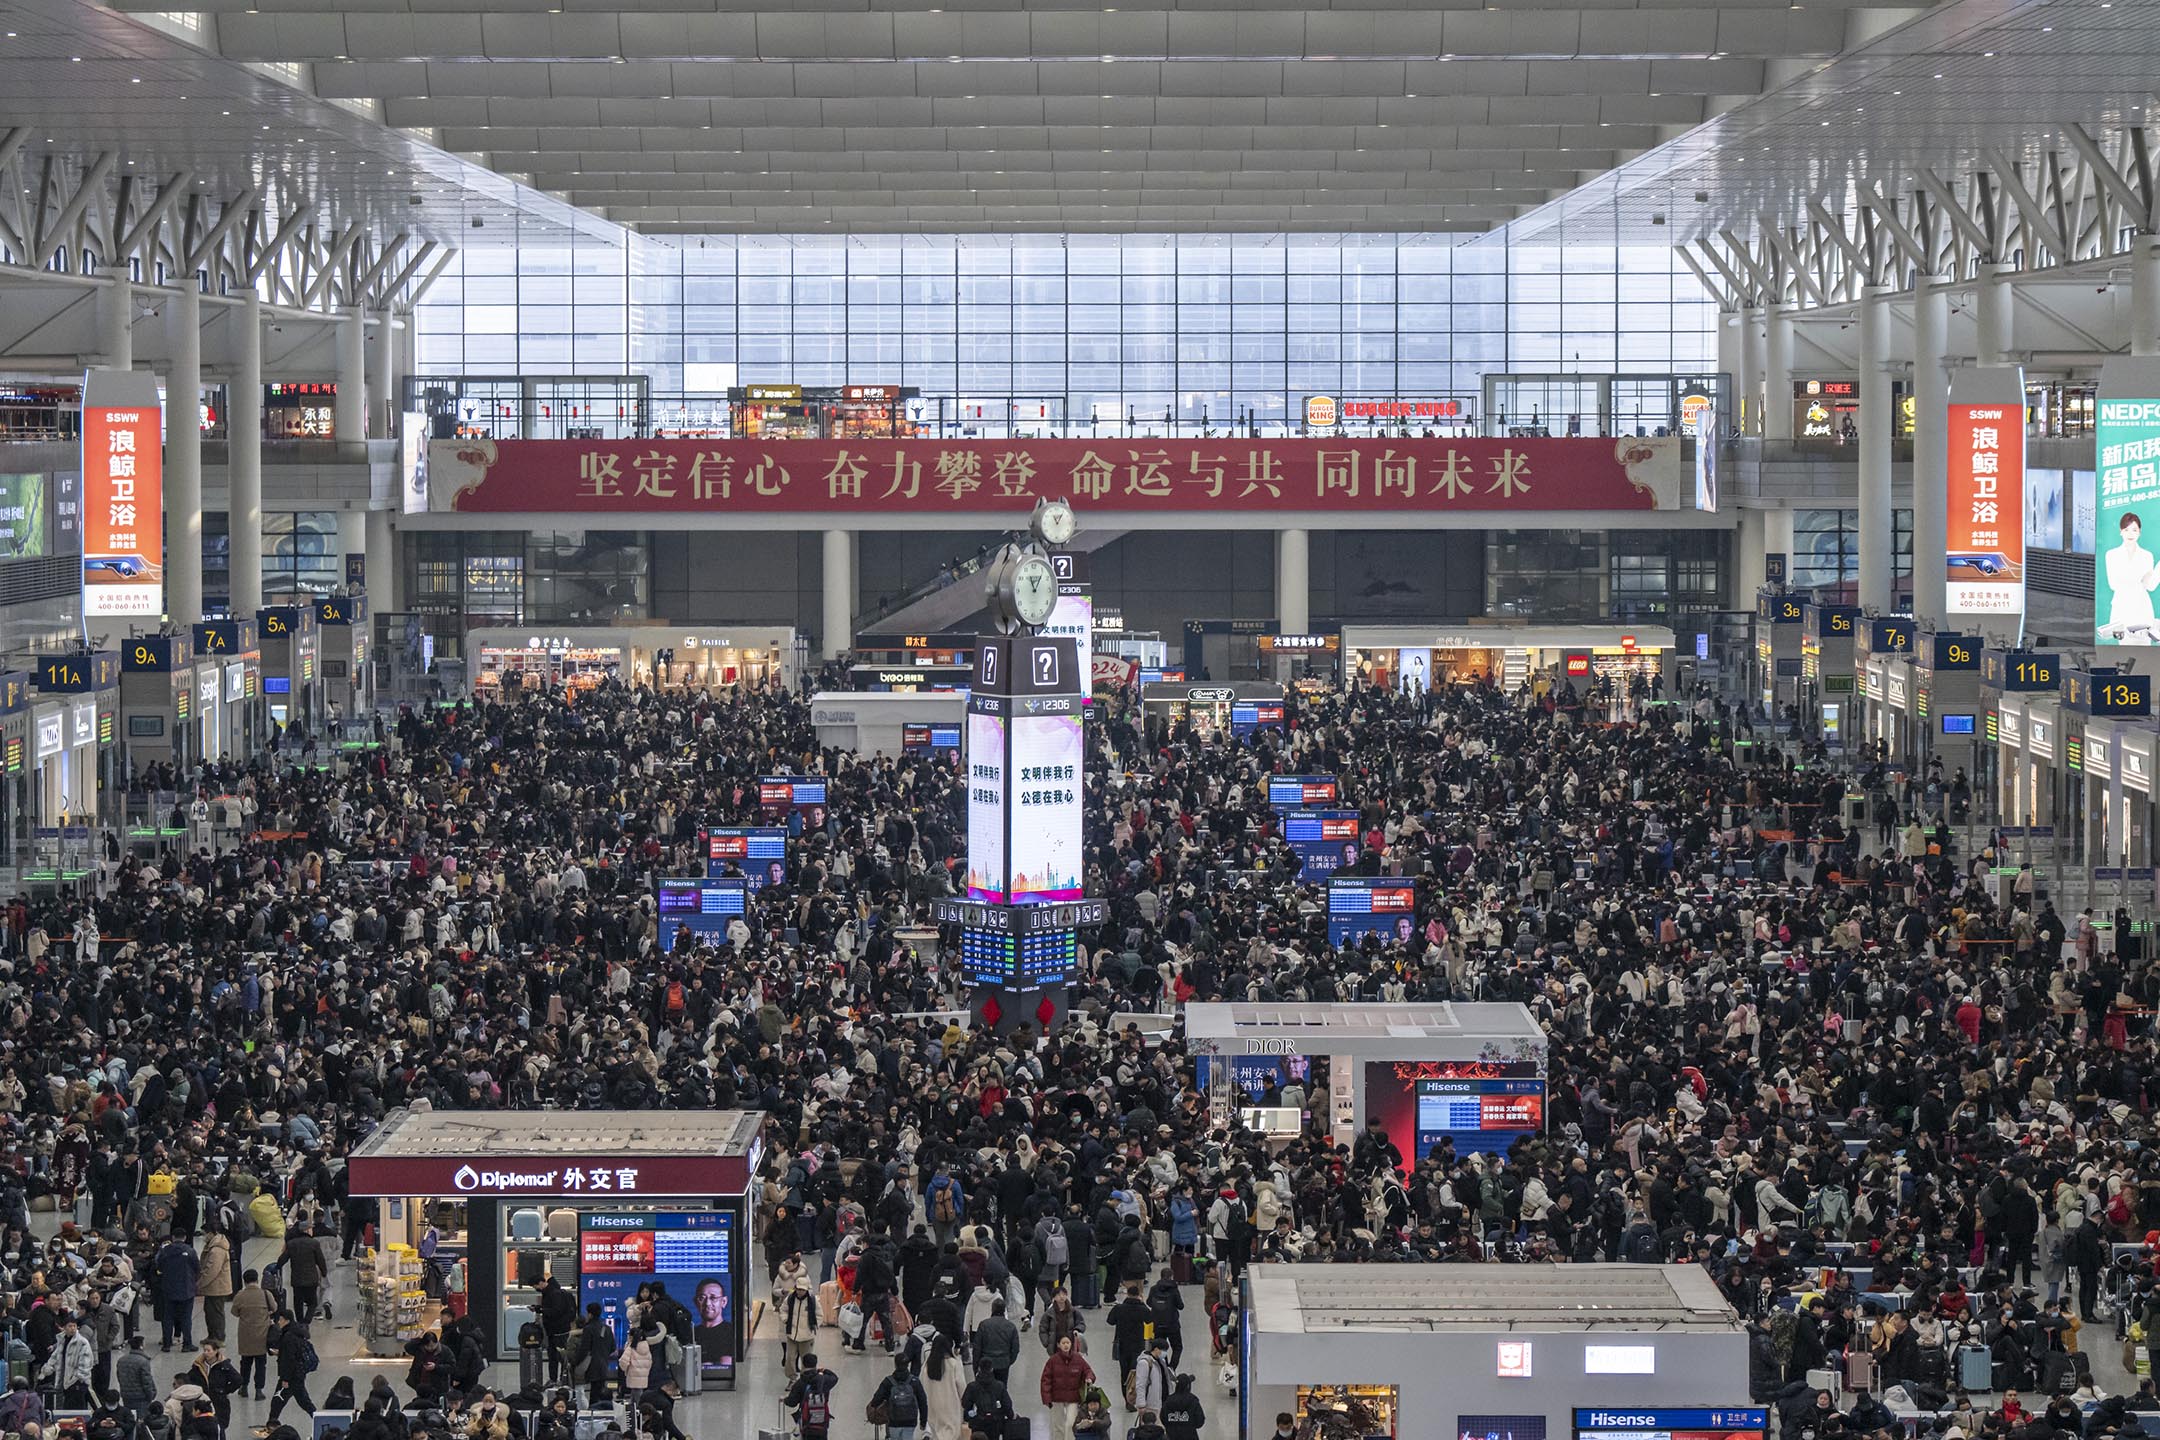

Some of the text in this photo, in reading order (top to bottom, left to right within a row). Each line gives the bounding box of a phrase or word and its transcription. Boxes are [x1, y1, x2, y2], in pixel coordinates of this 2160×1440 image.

[1825, 384, 1851, 393] 汉堡王
[304, 408, 331, 420] 永和
[1309, 412, 1334, 420] KING
[1344, 402, 1457, 416] BURGER KING
[1969, 410, 2002, 420] SSWW
[106, 412, 139, 423] SSWW
[304, 421, 331, 434] 大王
[109, 430, 136, 526] 浪鲸卫浴
[576, 449, 1532, 500] 坚定信心 奋力攀登 命运与共 同向未来
[1972, 427, 1999, 523] 浪鲸卫浴
[2102, 463, 2160, 496] 绿岛
[323, 605, 341, 620] 3A
[1783, 602, 1800, 618] 3B
[267, 617, 287, 632] 5A
[1831, 615, 1850, 630] 5B
[205, 631, 225, 648] 7A
[1885, 629, 1905, 646] 7B
[135, 647, 157, 664] 9A
[1949, 645, 1970, 662] 9B
[1568, 661, 1587, 670] LEGO
[2015, 663, 2050, 682] 11B
[48, 665, 81, 684] 11A
[880, 672, 903, 682] breo
[2102, 685, 2140, 705] 13B
[985, 700, 999, 710] 12306
[1043, 700, 1070, 710] 12306
[973, 764, 999, 780] 文明伴我行
[1021, 765, 1074, 781] 文明伴我行
[973, 788, 999, 804] 公德在我心
[1021, 789, 1074, 805] 公德在我心
[1246, 1039, 1296, 1054] DIOR
[1427, 1082, 1470, 1091] Hisense
[481, 1167, 639, 1190] Diplomat 外交官
[591, 1216, 644, 1226] Hisense
[585, 1253, 611, 1261] 新春快乐
[1590, 1413, 1655, 1426] Hisense
[1727, 1413, 1748, 1422] 卫生间
